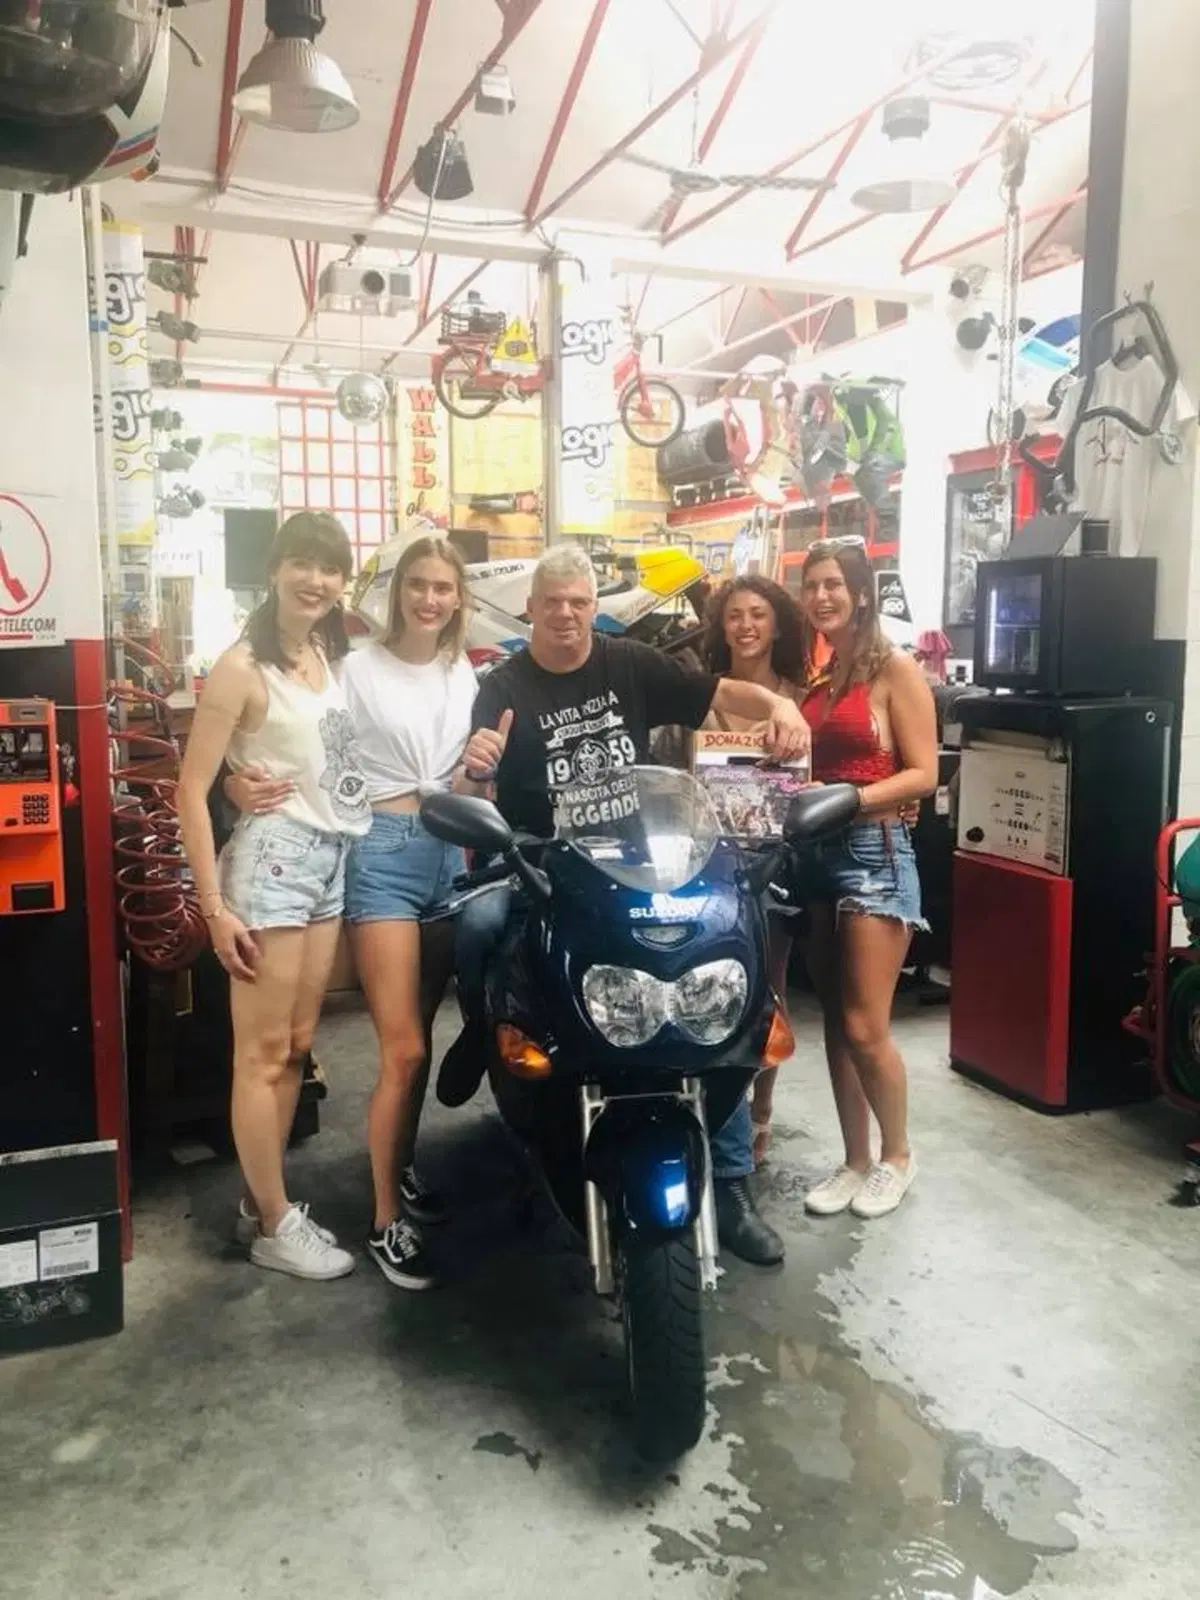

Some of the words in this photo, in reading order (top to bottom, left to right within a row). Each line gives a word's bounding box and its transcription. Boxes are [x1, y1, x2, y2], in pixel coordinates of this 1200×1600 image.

[406, 387, 437, 490] WALL
[539, 712, 556, 730] LA
[554, 706, 582, 725] VITA
[607, 689, 620, 706] A
[546, 758, 571, 784] 19
[607, 735, 636, 768] 59
